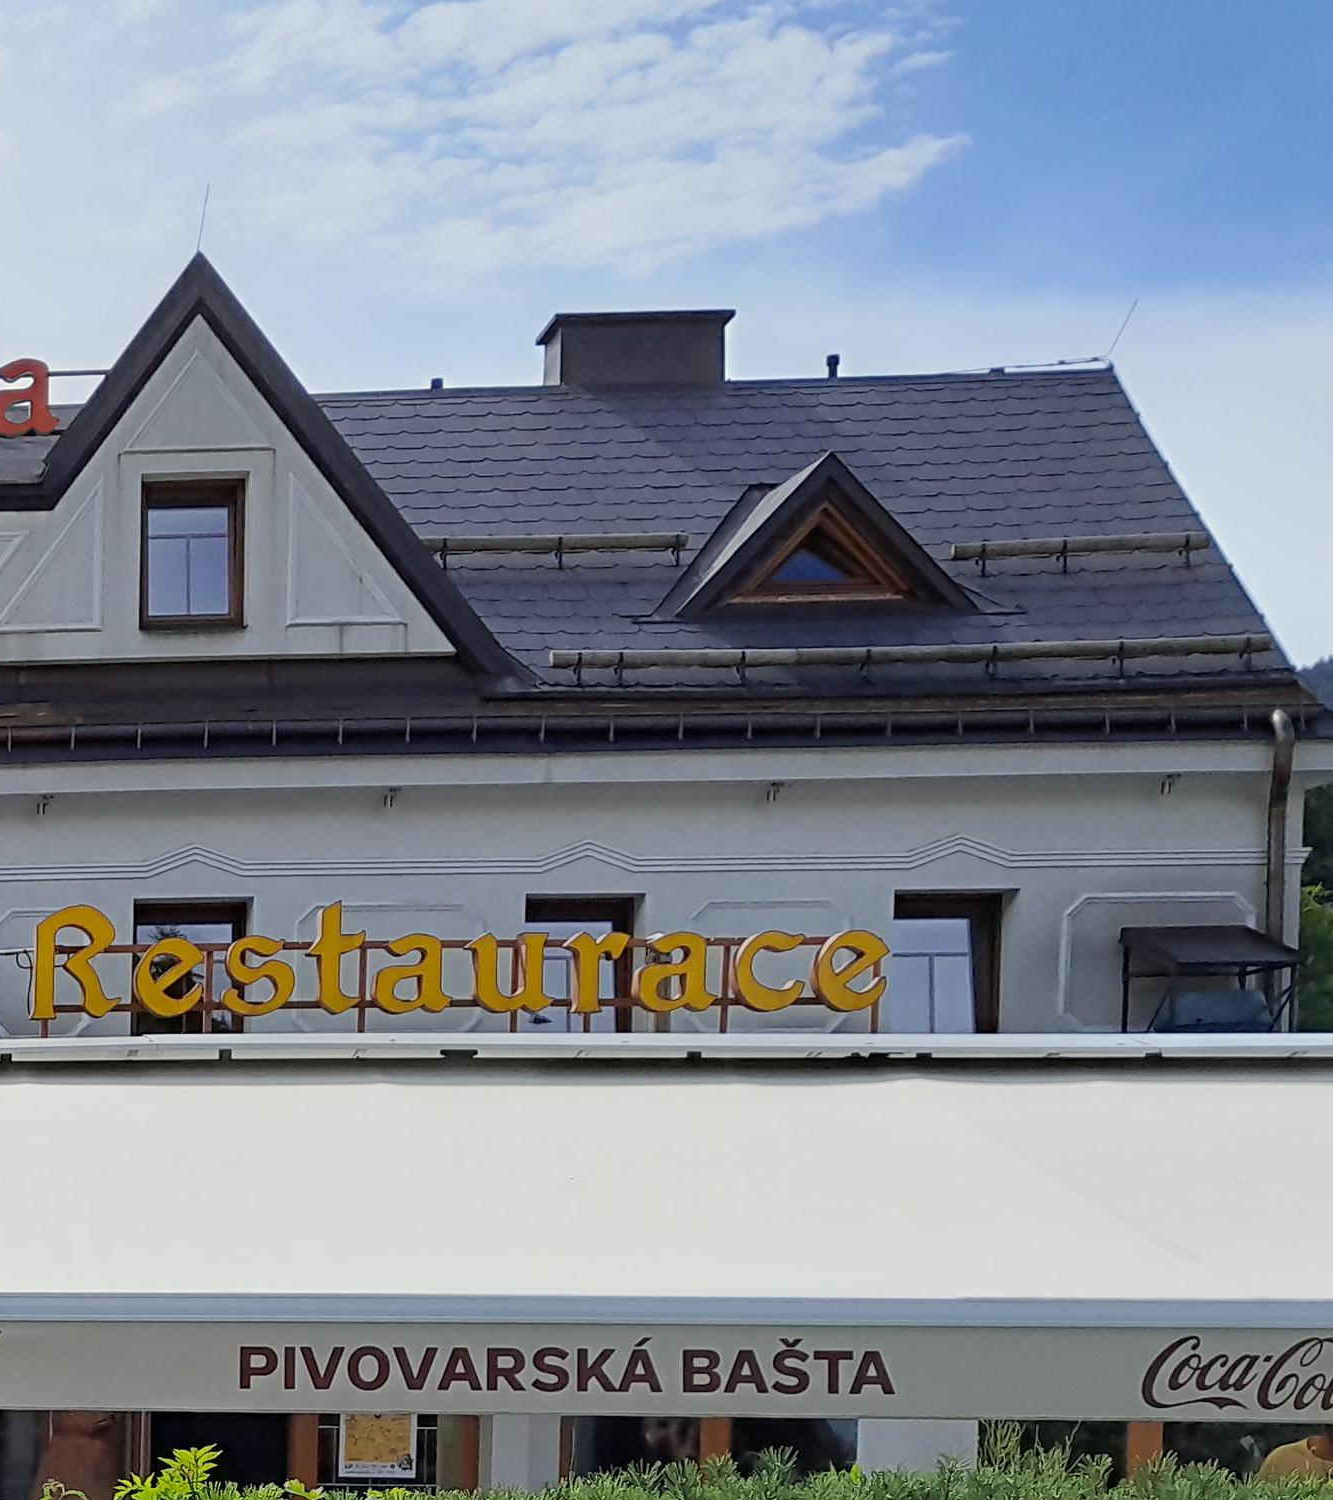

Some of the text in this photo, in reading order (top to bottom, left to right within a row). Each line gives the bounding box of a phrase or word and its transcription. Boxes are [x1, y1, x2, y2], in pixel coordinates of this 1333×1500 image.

[30, 900, 890, 1020] Restaurace
[239, 1336, 897, 1395] PIVOVARSKÁ BAŠTA
[1141, 1335, 1333, 1411] Coca-Co
